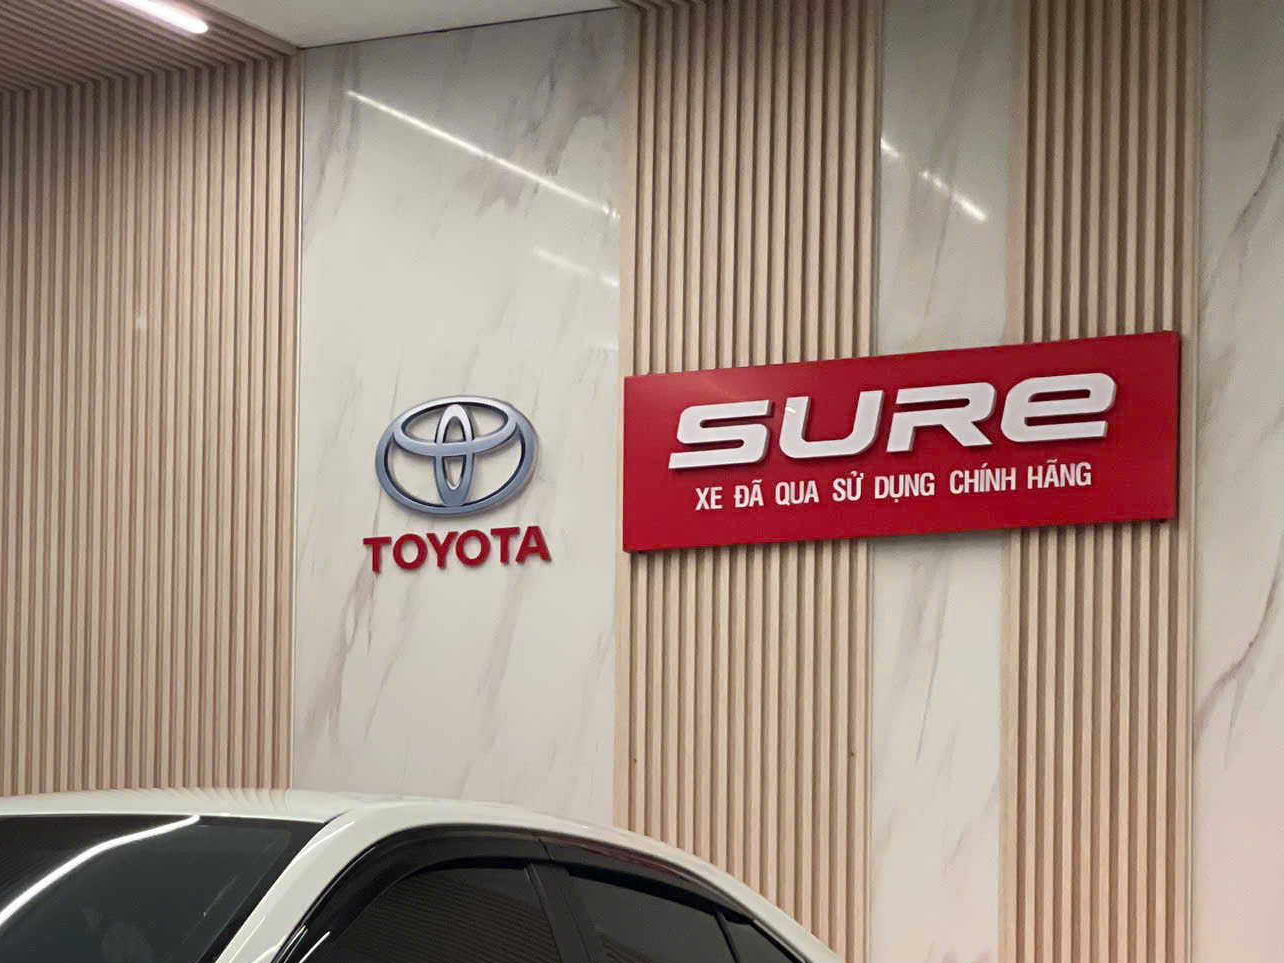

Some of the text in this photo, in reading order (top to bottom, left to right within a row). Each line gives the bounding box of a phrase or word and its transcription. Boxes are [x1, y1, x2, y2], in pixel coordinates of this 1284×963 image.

[695, 458, 1092, 511] XE ĐÃ QUA SỬ DỤNG CHÍNH HÃNG
[363, 526, 552, 573] TOYOTA
